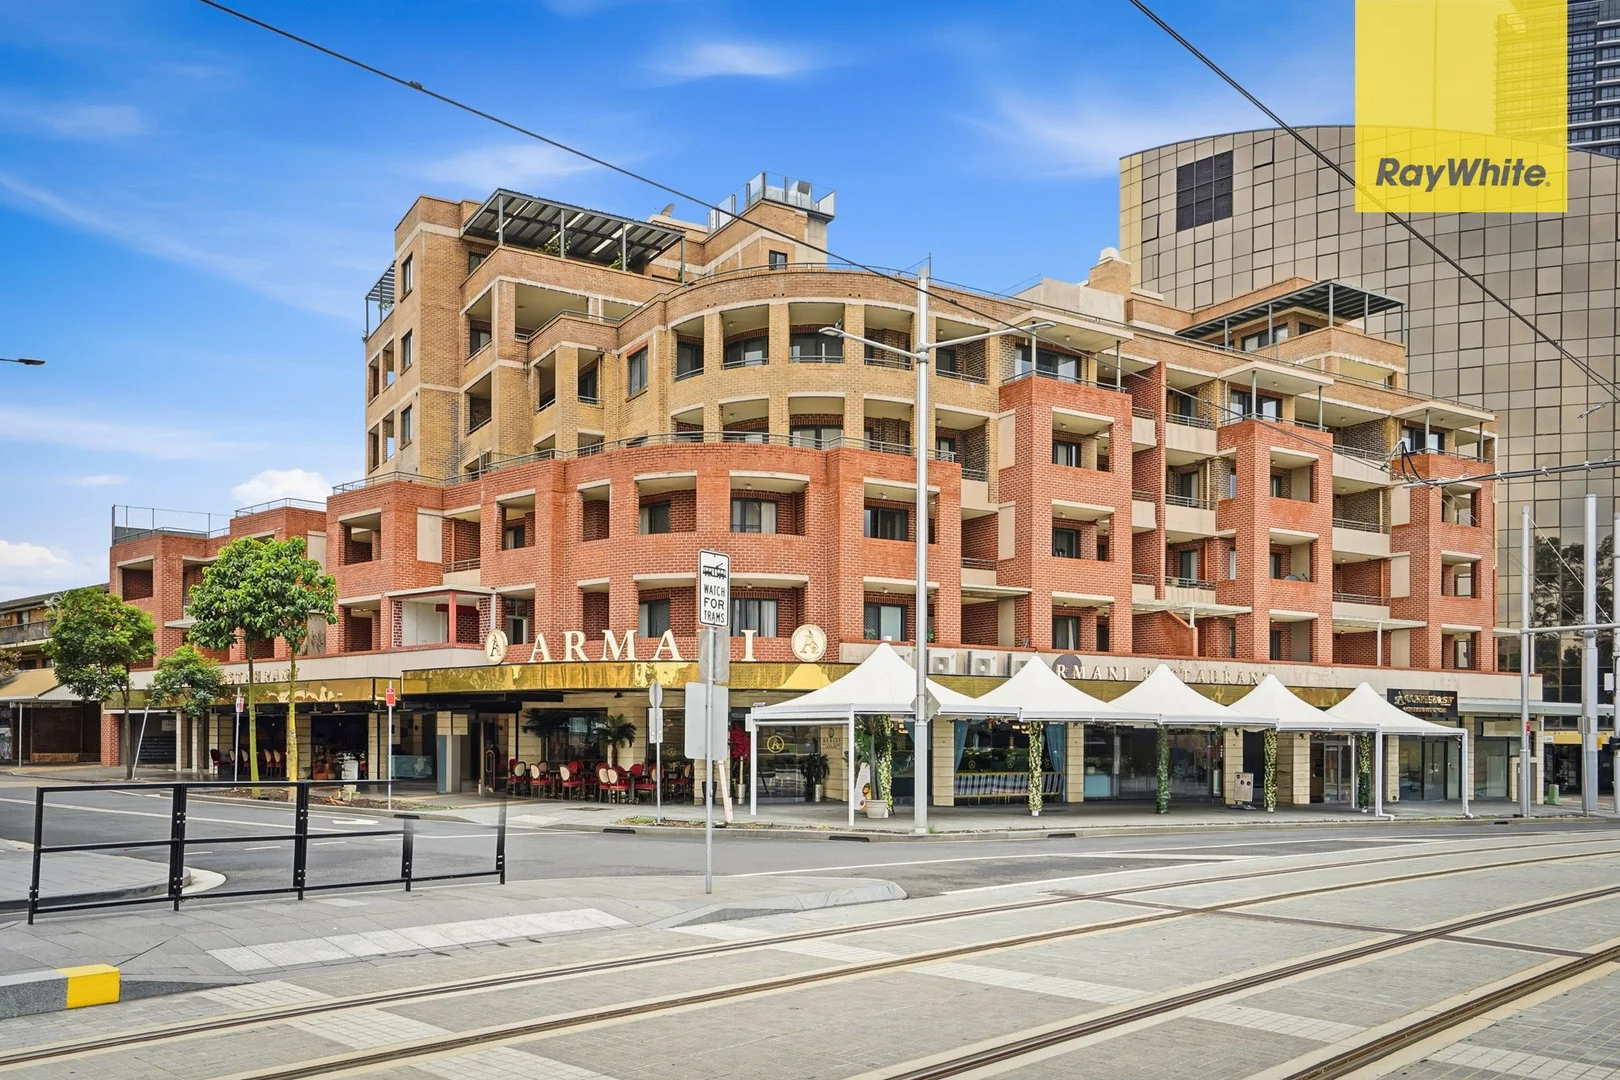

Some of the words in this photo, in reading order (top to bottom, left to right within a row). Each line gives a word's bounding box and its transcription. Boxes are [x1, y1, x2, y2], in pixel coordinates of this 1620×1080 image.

[704, 584, 726, 598] WATCH
[704, 597, 725, 611] FOR
[704, 610, 725, 624] TRAMS
[528, 629, 757, 663] ARMAI
[1056, 664, 1130, 681] RMANI
[1142, 667, 1268, 686] RTAURAN
